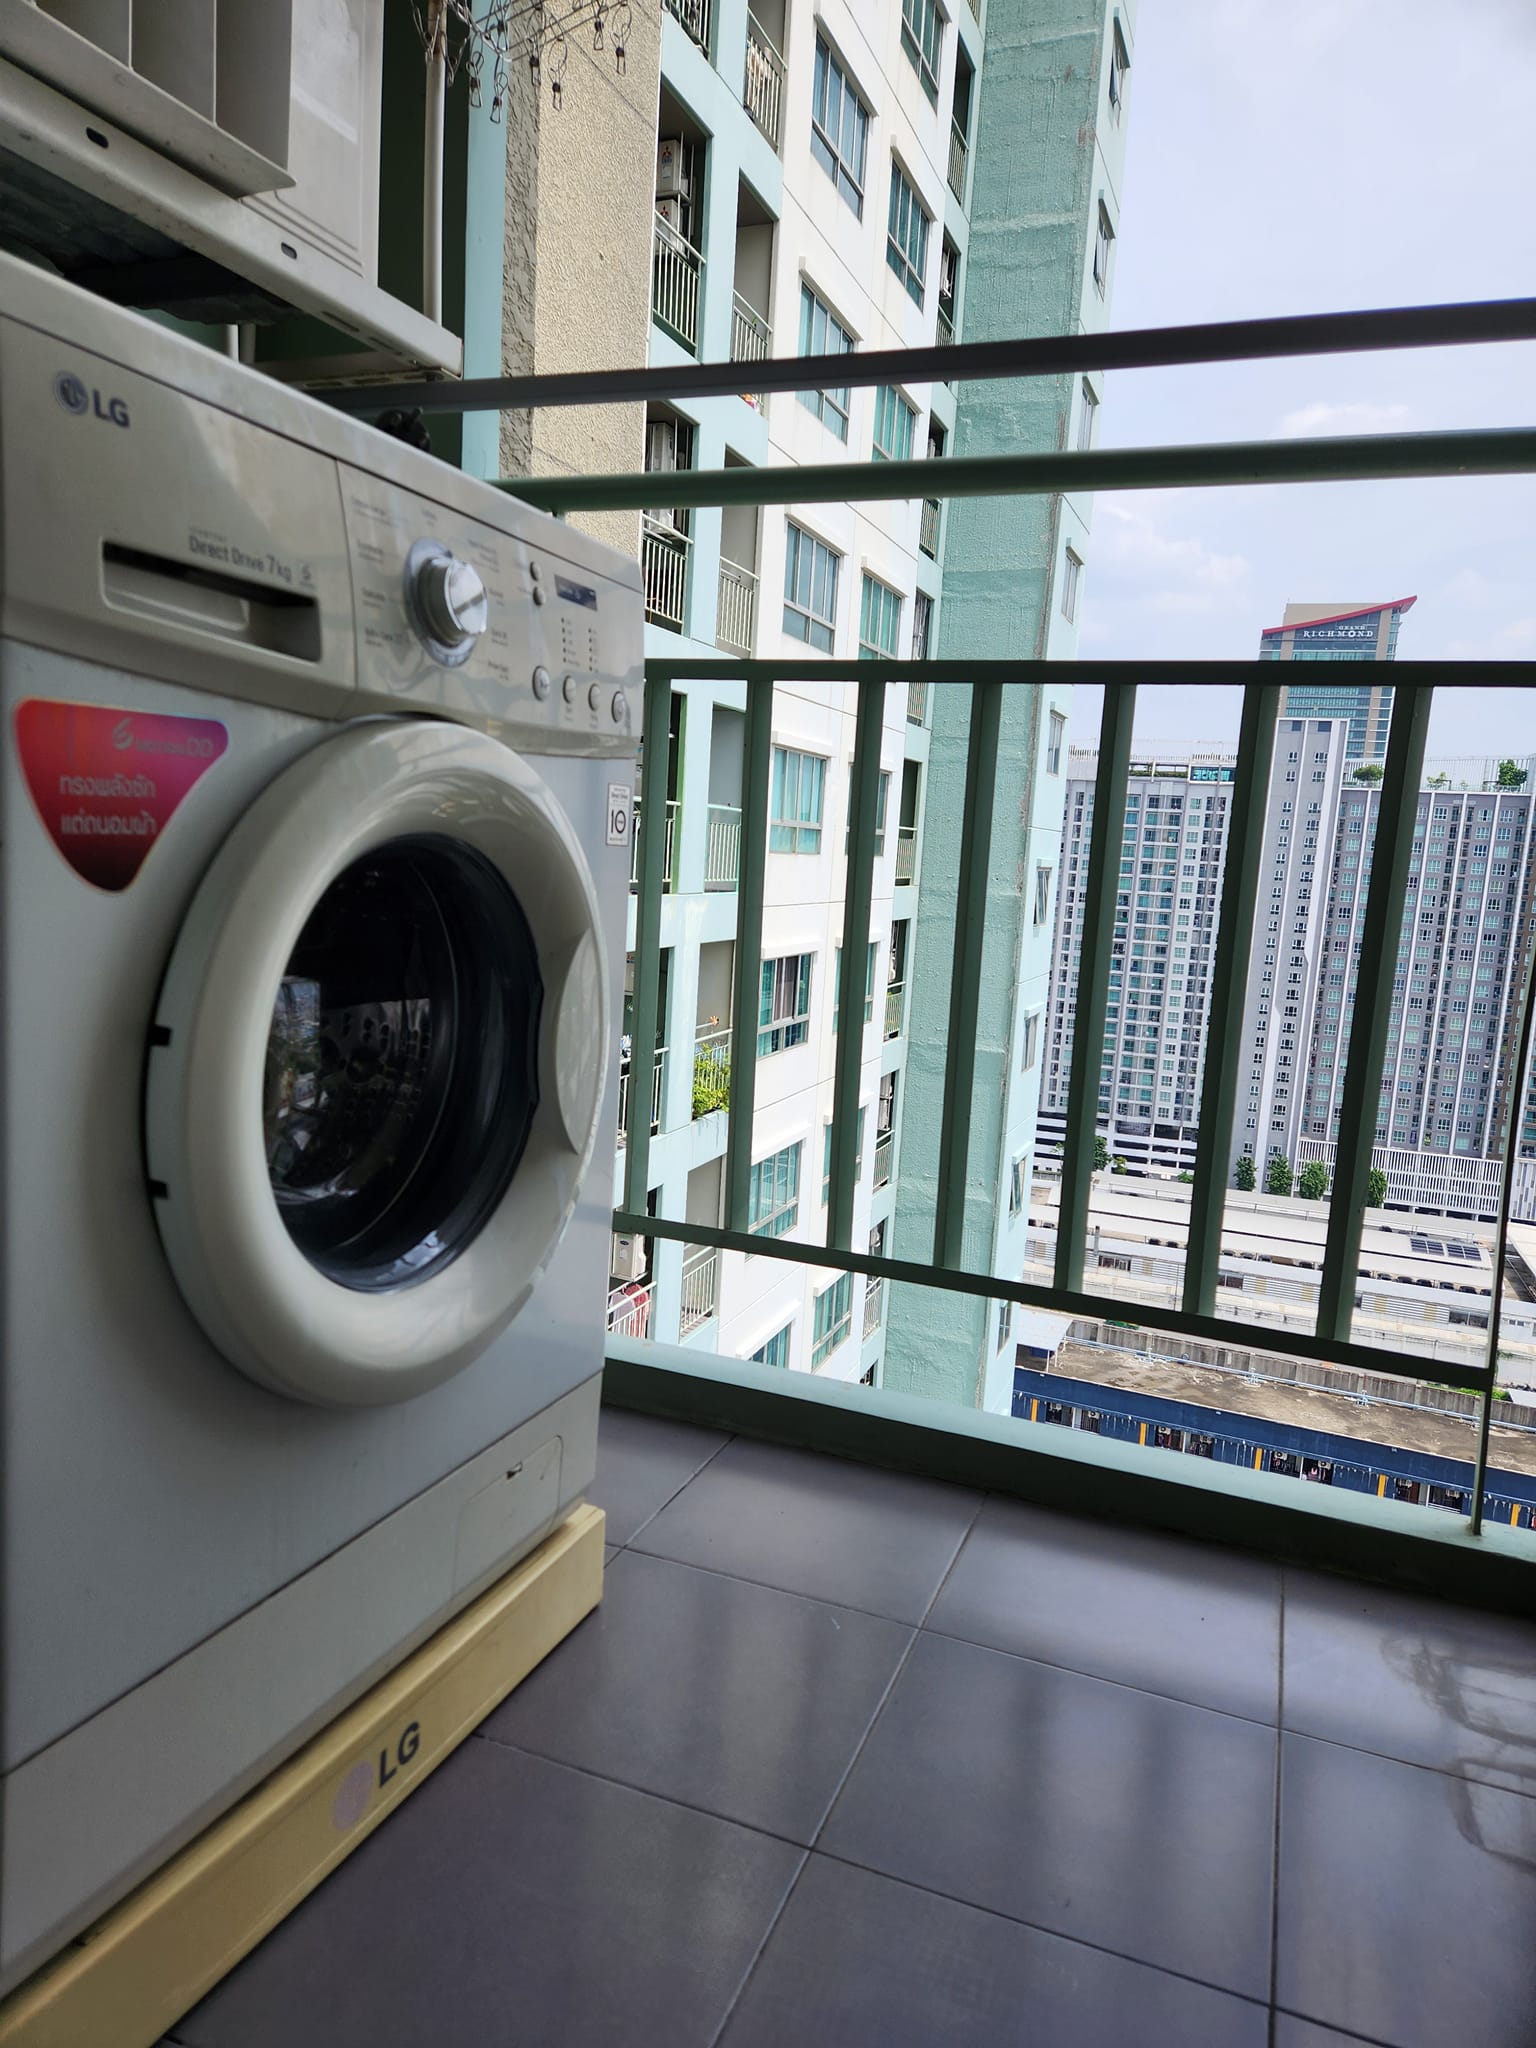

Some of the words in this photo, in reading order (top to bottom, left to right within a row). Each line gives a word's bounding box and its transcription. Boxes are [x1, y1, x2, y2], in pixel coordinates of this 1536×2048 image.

[93, 388, 130, 428] LG
[189, 535, 229, 563] Direct
[231, 546, 264, 573] Drive
[1303, 630, 1374, 638] RICHMOND
[610, 809, 627, 835] 10
[379, 1721, 420, 1789] LG
